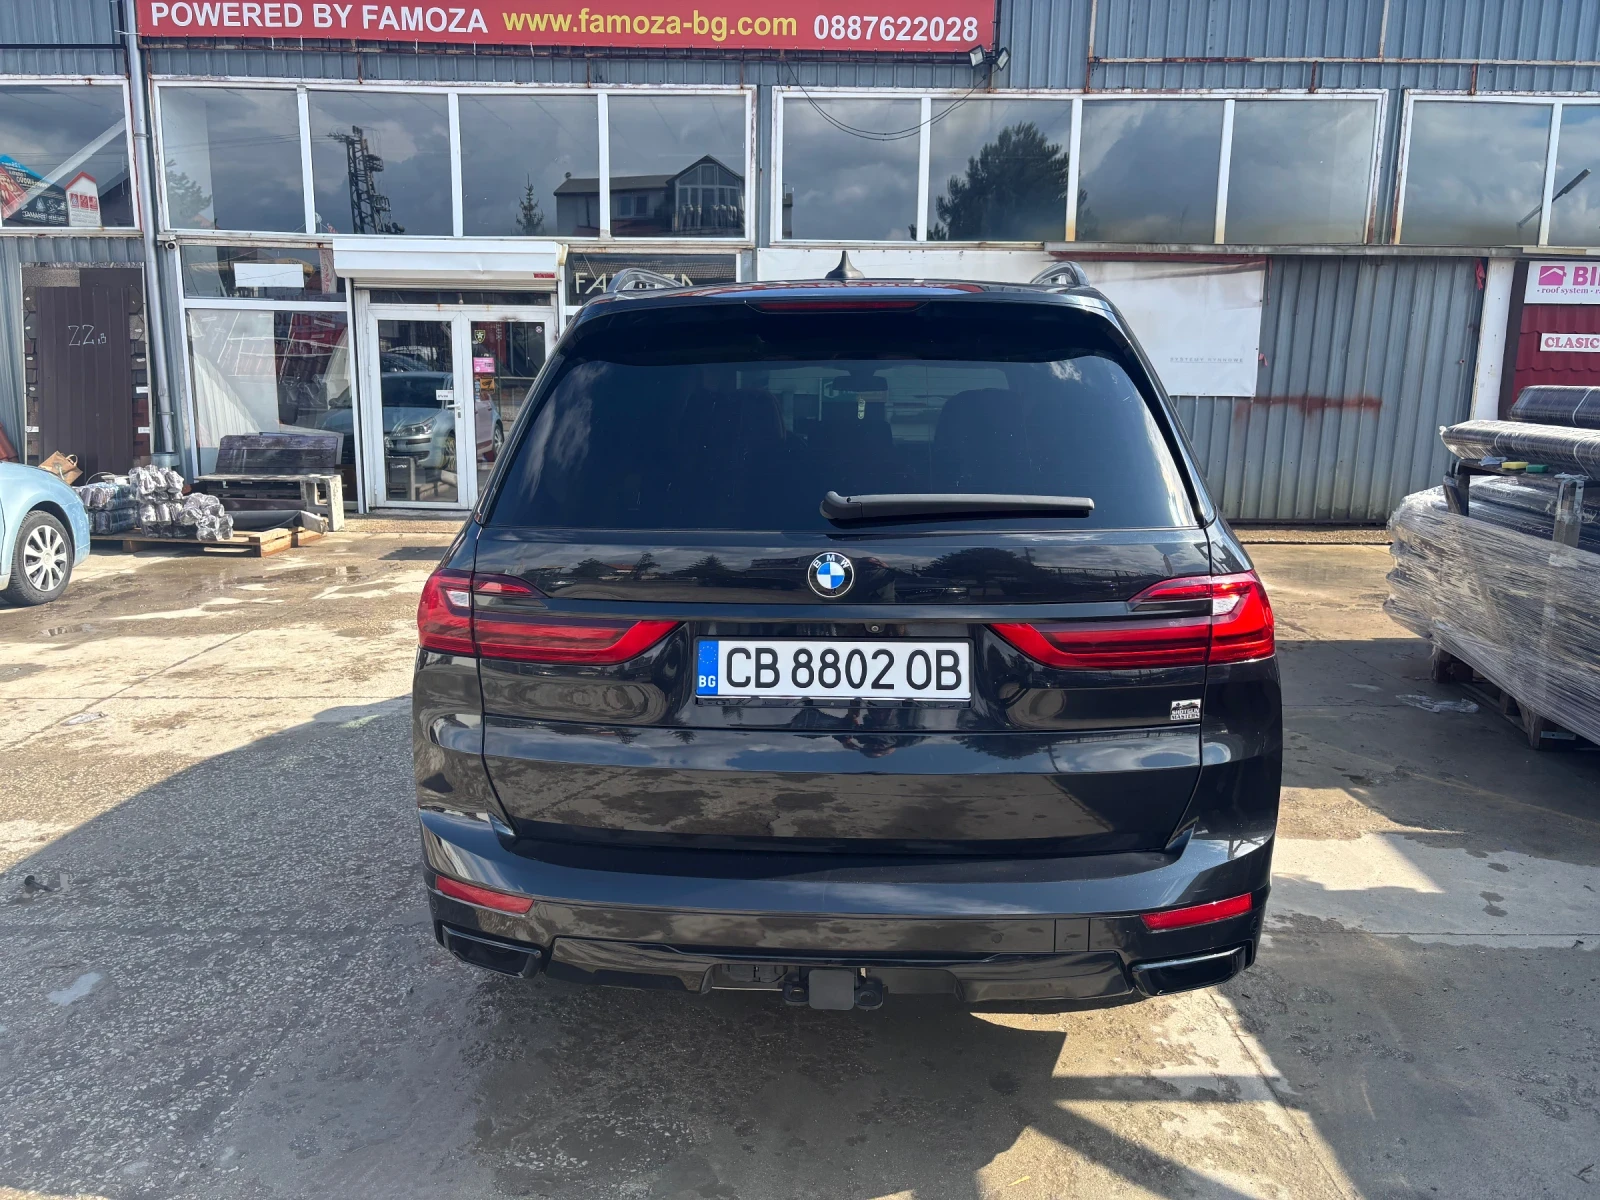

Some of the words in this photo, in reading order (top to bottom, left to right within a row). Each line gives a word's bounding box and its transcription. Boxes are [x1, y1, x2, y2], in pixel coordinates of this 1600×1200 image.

[151, 2, 303, 28] POWERED
[313, 3, 353, 29] BY
[362, 5, 489, 34] FAMOZA
[502, 7, 798, 41] www.famoza-bg.com
[813, 14, 979, 42] 0887622028
[1572, 266, 1600, 286] BI
[1541, 286, 1561, 294] roof
[1561, 287, 1589, 295] system
[812, 553, 850, 569] BMW
[726, 647, 781, 689] CB
[791, 648, 895, 690] 8802
[698, 675, 716, 688] BG
